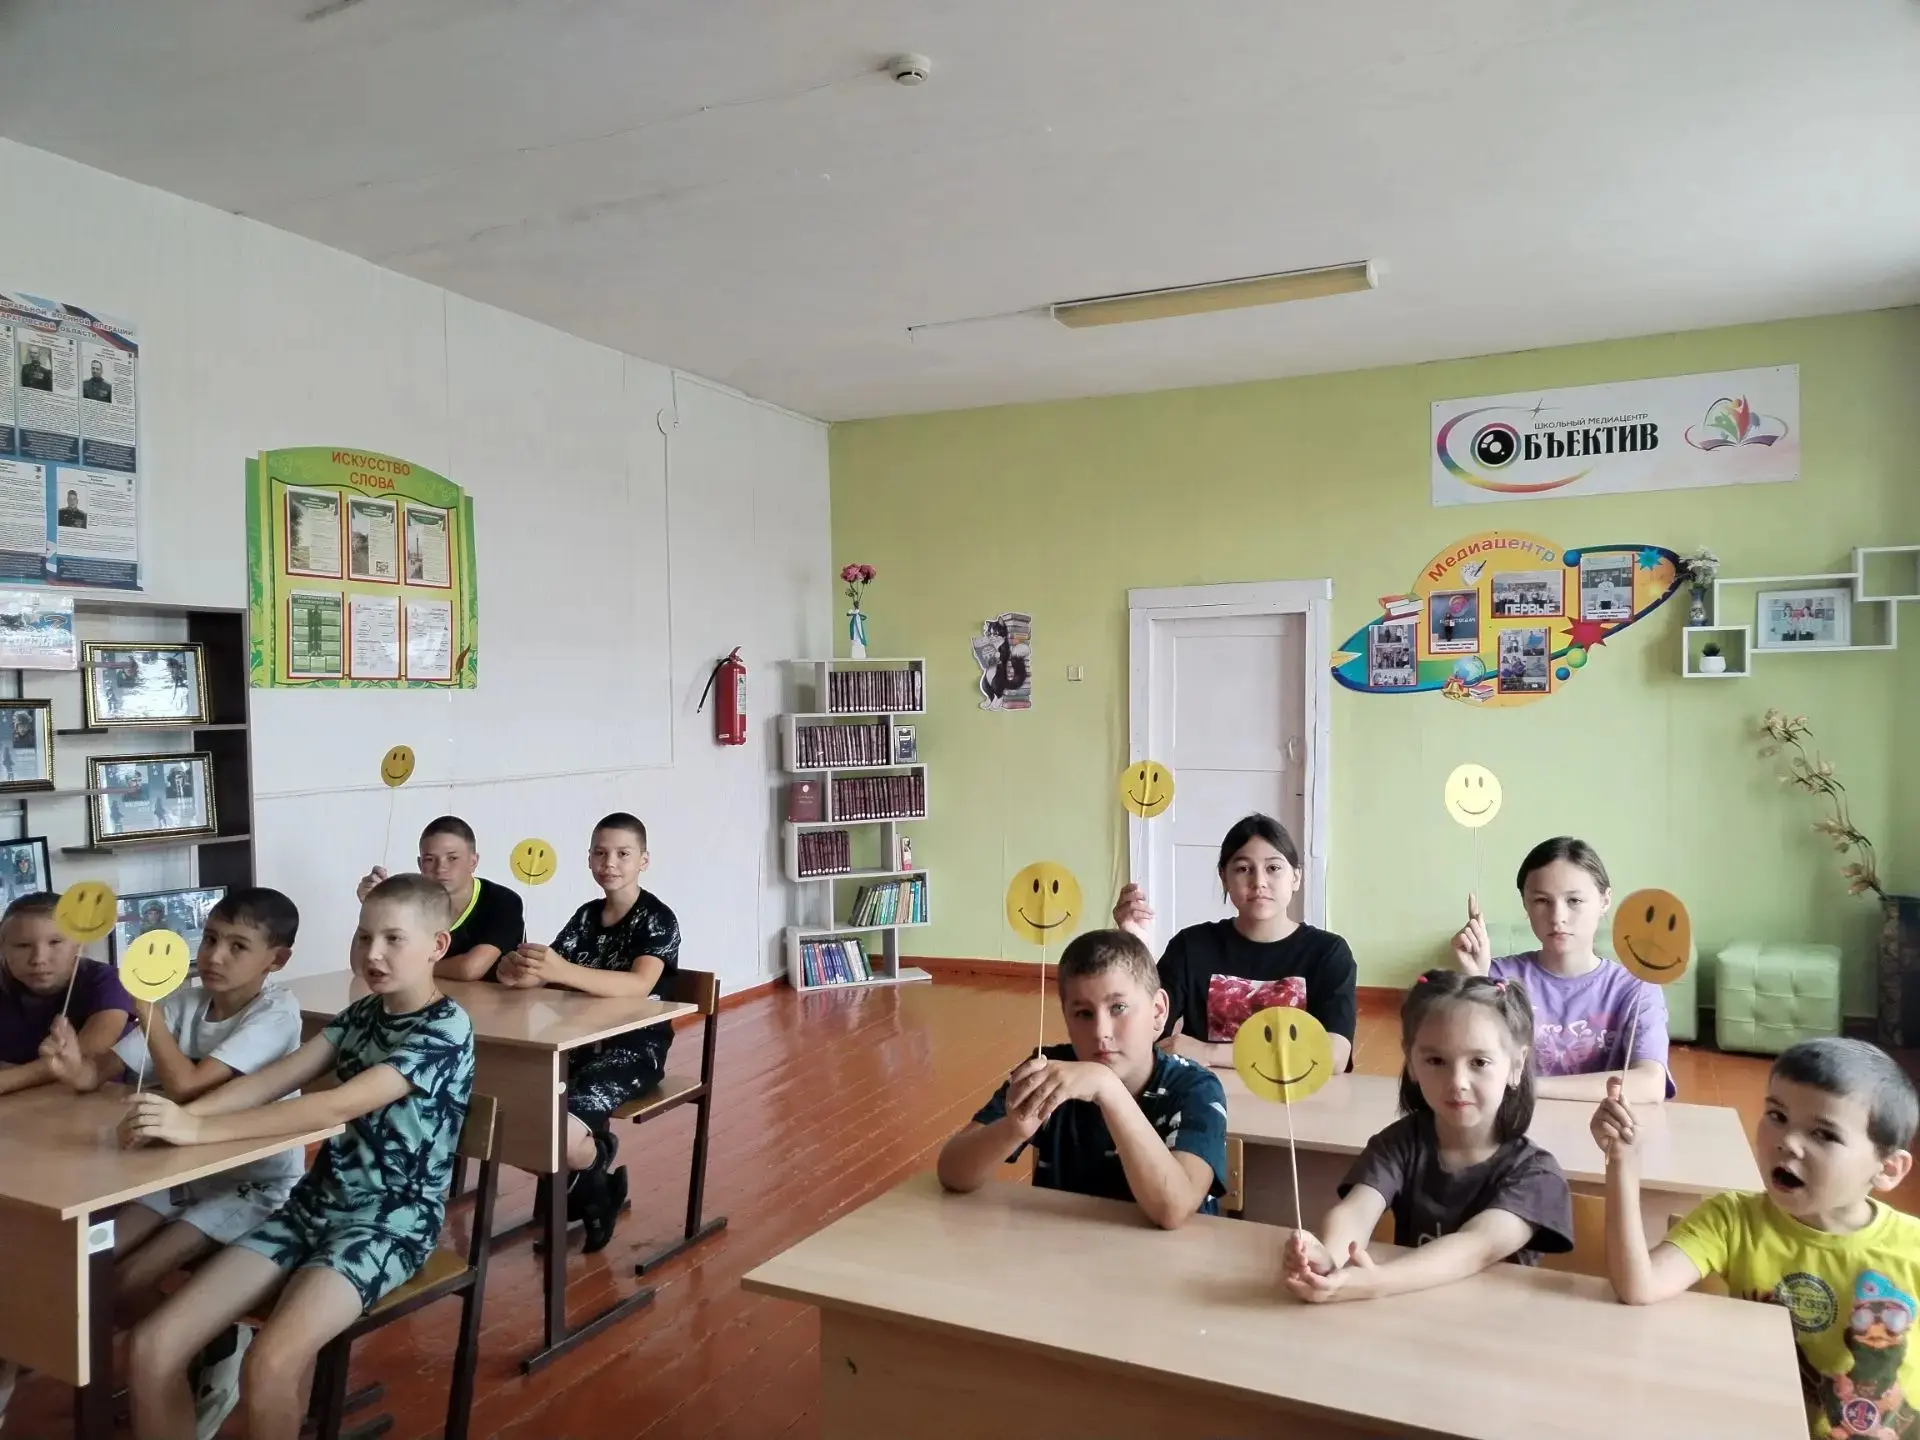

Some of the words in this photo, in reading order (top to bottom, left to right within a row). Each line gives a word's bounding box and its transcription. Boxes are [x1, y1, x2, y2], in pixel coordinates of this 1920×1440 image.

[51, 311, 90, 327] ВОЕННОЙ
[60, 326, 97, 340] ОБЛАСТИ
[1534, 418, 1586, 430] ШКОЛЬНЫЙ
[1588, 413, 1649, 425] МЕДИАЦЕНТР
[332, 451, 411, 476] ИСКУССТВО
[350, 472, 395, 490] СЛОВА
[1428, 538, 1556, 582] Медиацентр
[1504, 603, 1556, 616] ПЕРВЫЕ
